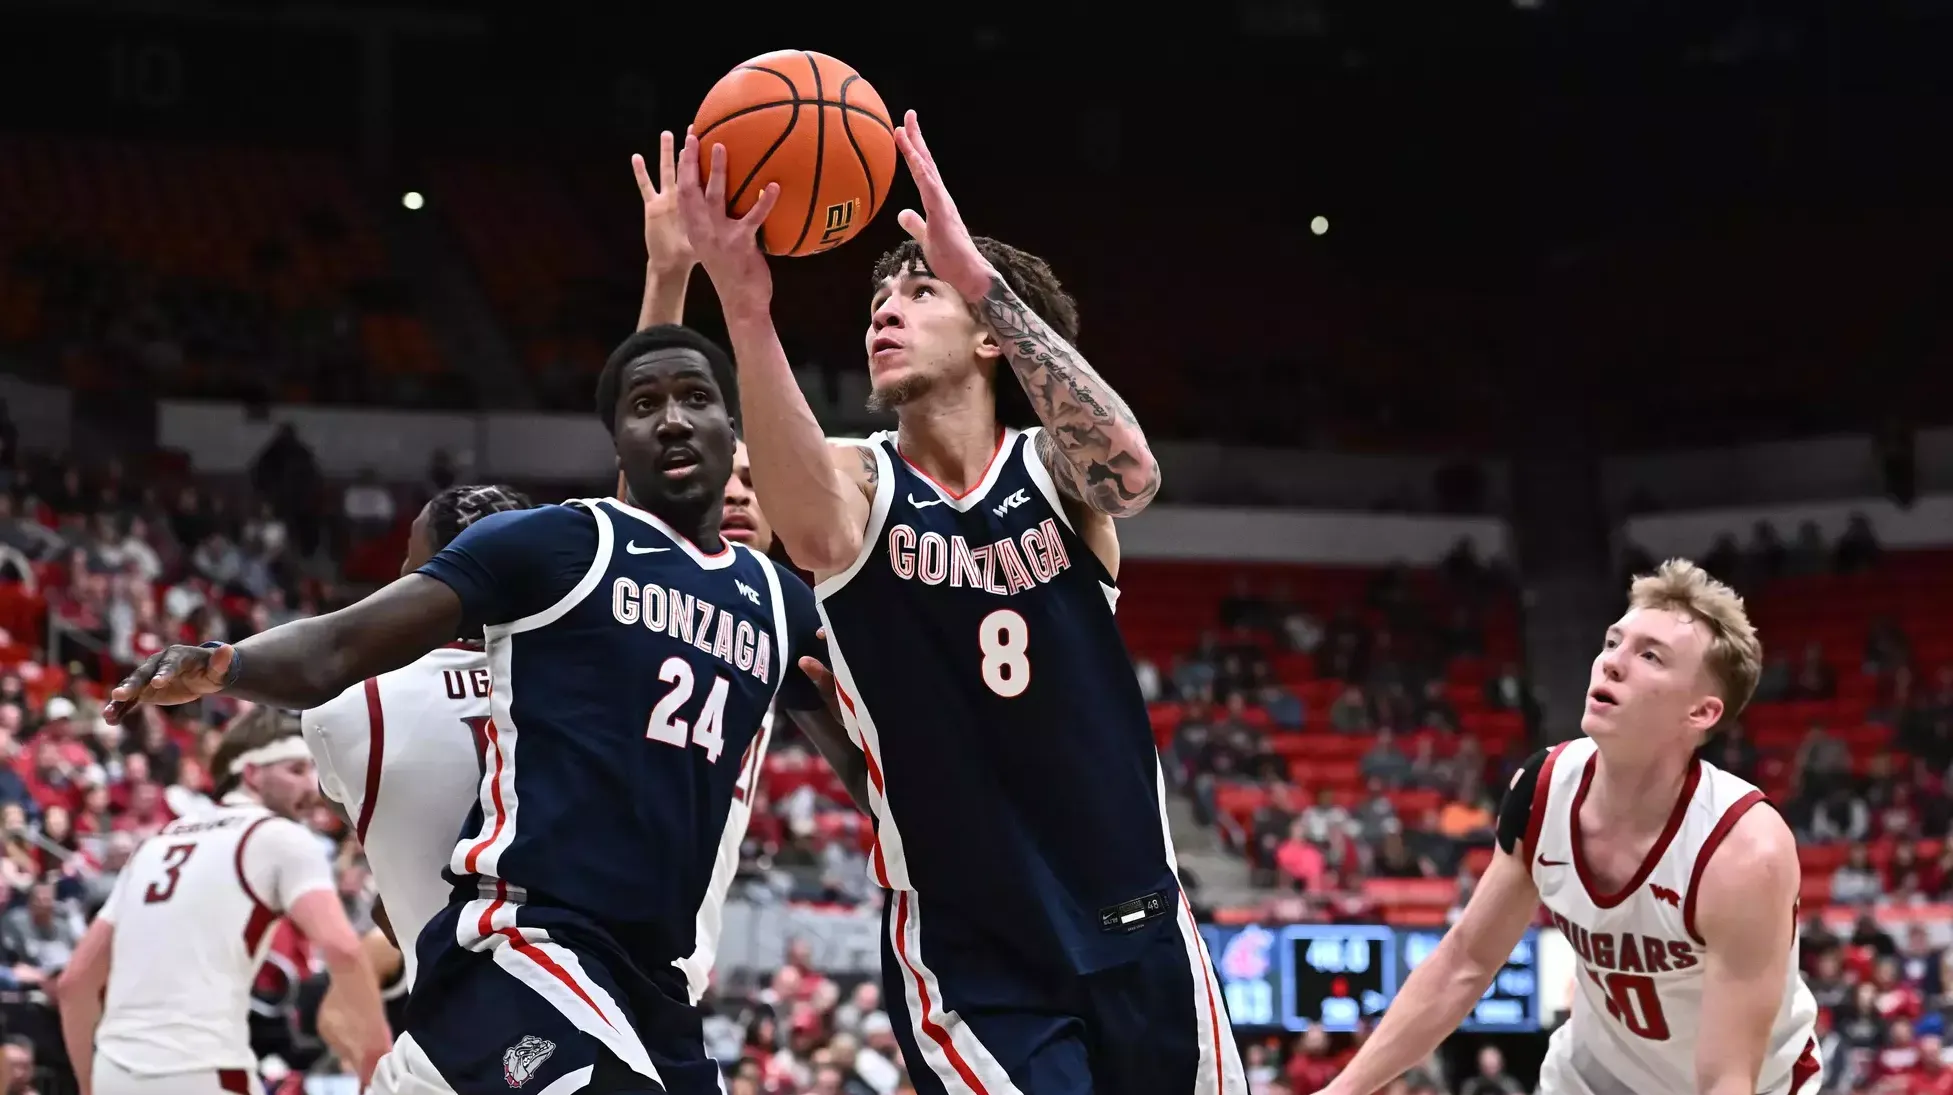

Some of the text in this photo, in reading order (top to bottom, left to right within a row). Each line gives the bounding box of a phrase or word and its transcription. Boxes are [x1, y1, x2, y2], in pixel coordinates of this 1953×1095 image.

[992, 487, 1031, 519] WCC
[888, 517, 1072, 597] GONZAGA
[612, 576, 771, 684] GONZAGA
[978, 608, 1031, 699] 8
[443, 669, 490, 700] UG
[645, 655, 730, 765] 24
[144, 842, 198, 905] 3
[1147, 899, 1159, 911] 48
[1553, 911, 1699, 974] OUGARS
[1584, 966, 1672, 1042] 10
